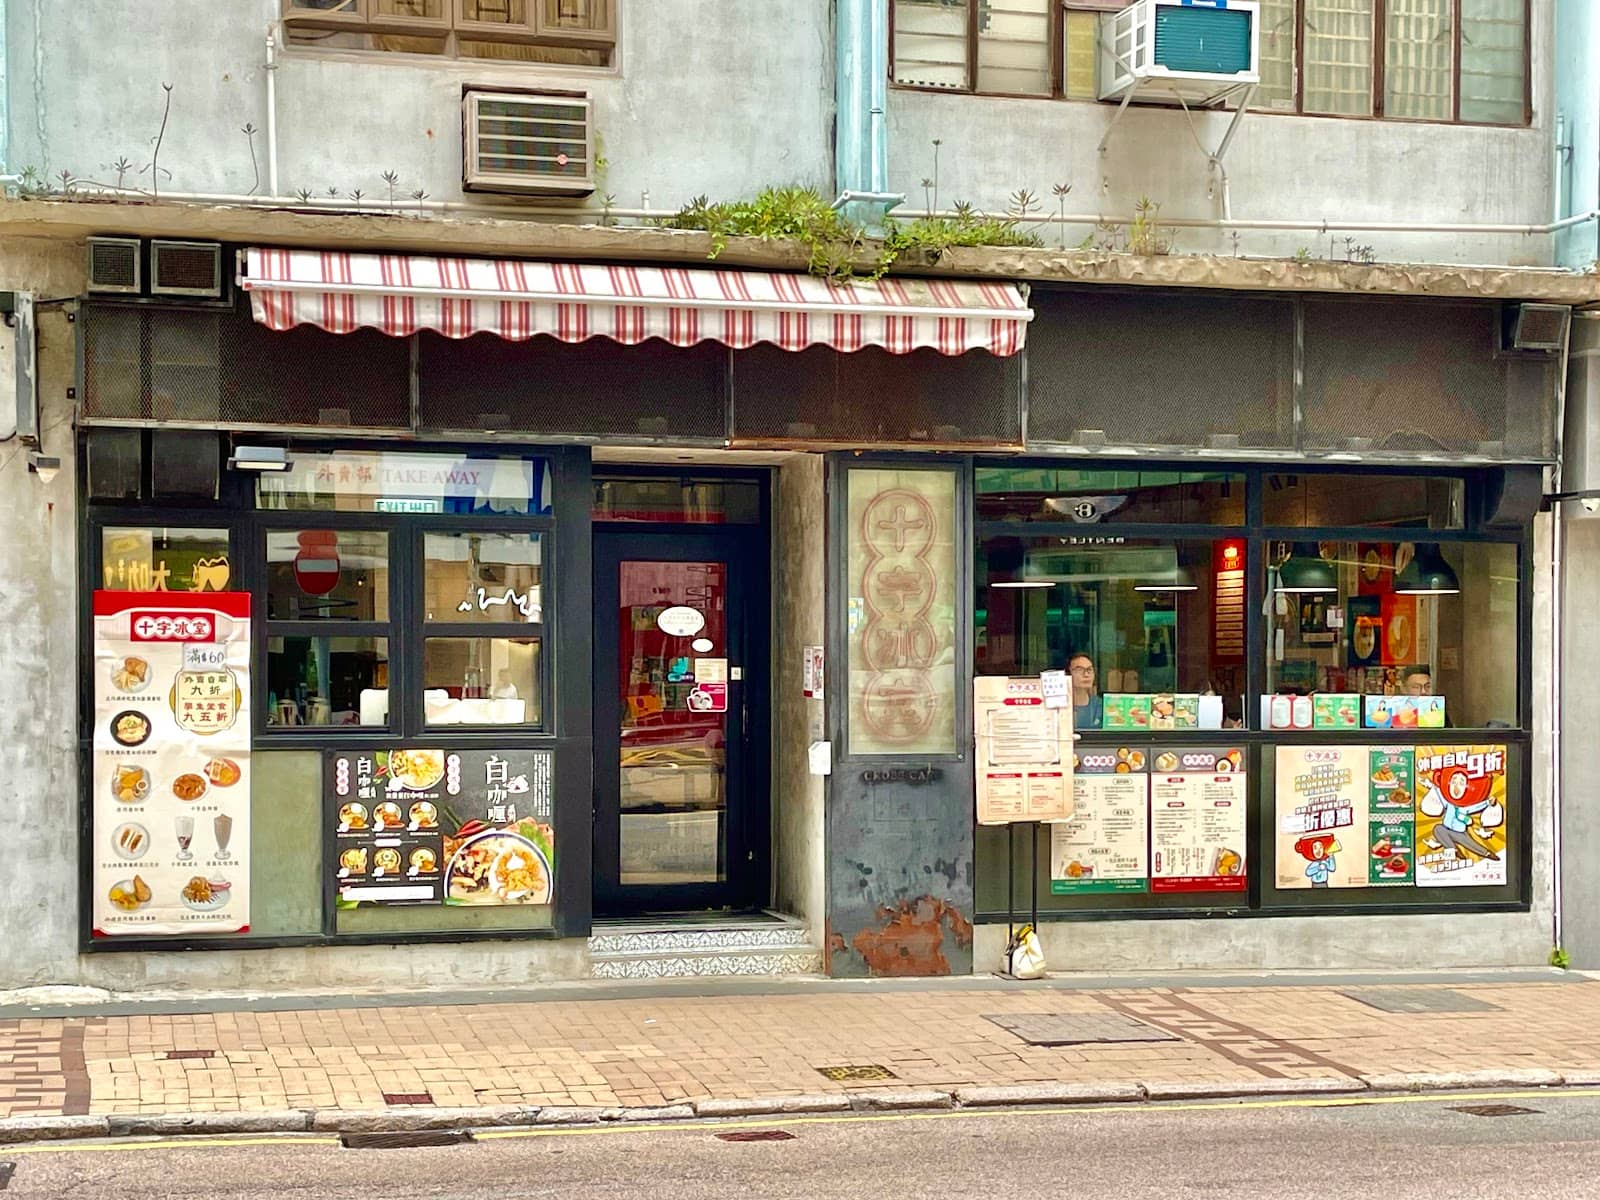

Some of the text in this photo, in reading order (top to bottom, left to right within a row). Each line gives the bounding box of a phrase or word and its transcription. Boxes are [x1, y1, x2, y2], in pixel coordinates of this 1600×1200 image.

[384, 470, 480, 486] TAKE AWAY
[376, 502, 407, 512] EXIT
[138, 621, 207, 635] 十字冰室
[191, 685, 220, 696] 九折
[183, 712, 228, 722] 九五折
